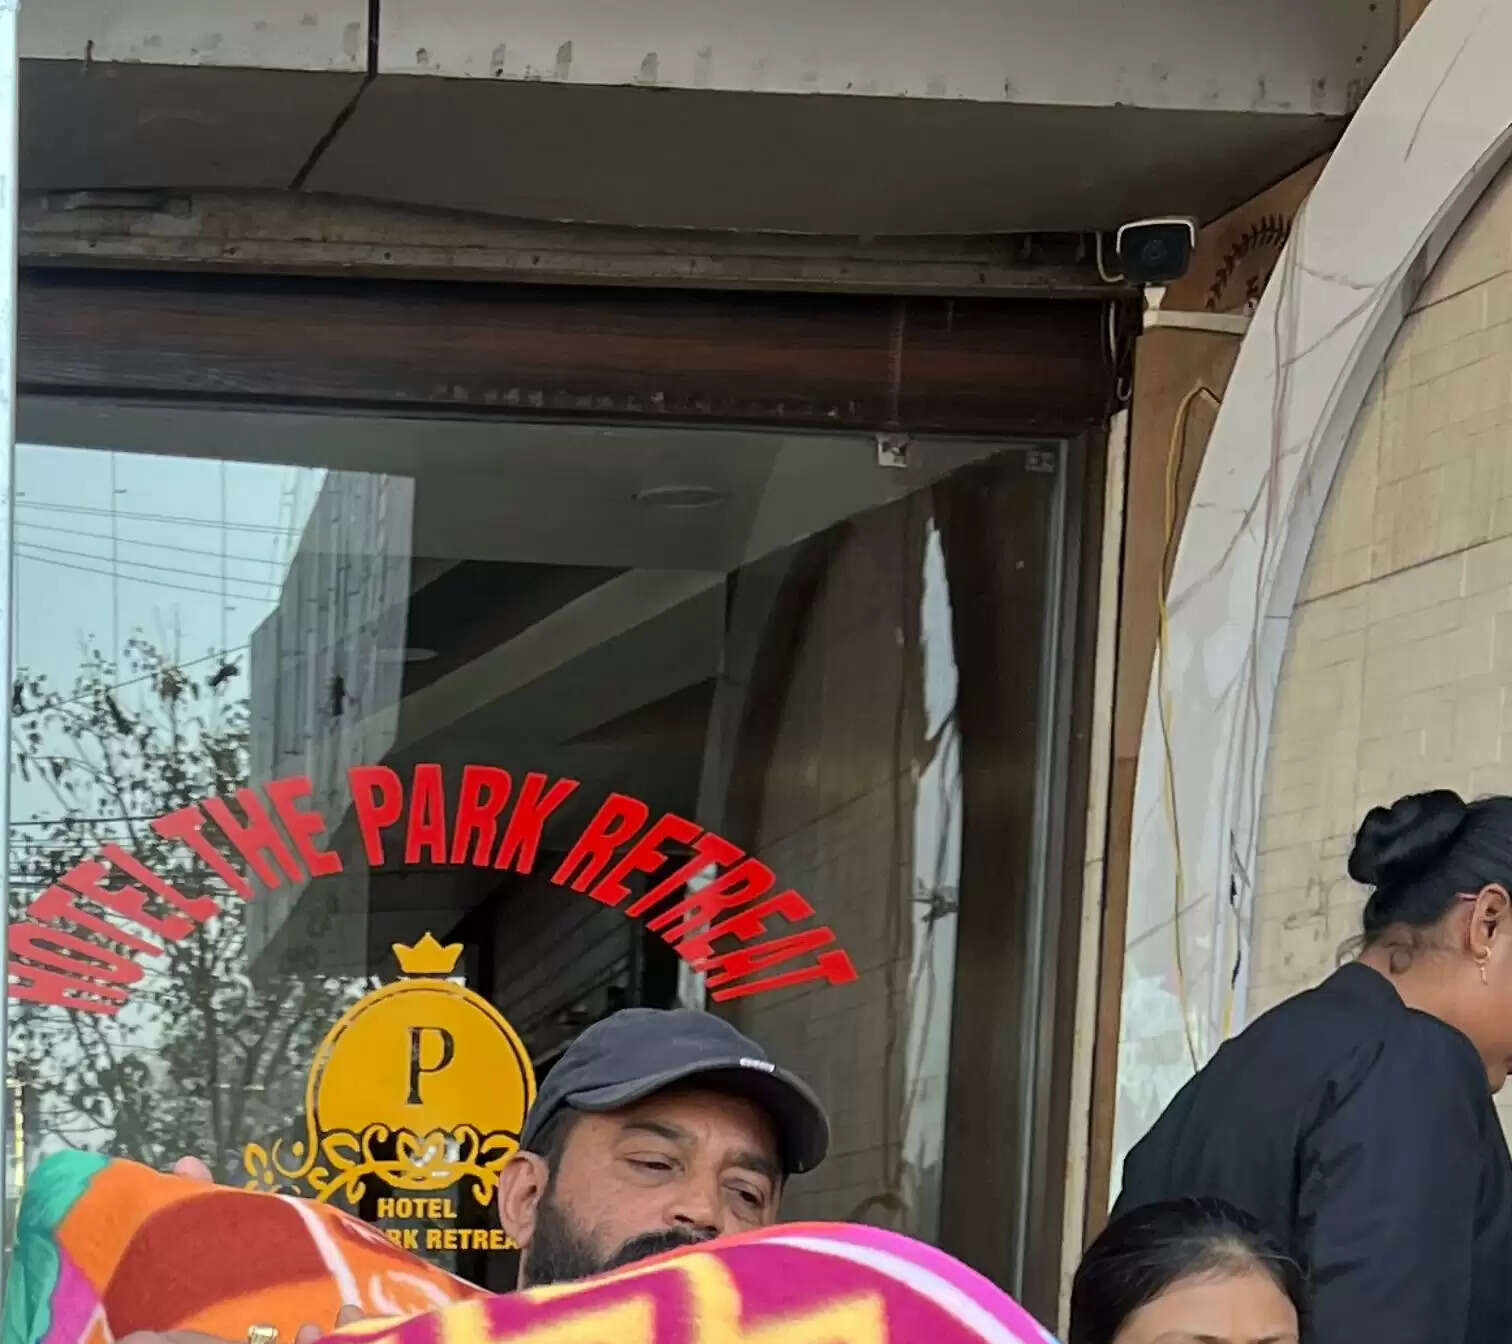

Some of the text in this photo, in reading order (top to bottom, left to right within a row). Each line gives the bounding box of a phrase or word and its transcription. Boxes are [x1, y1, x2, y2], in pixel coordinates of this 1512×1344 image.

[8, 763, 859, 1016] HOTEL THE PARK RETREAT
[407, 1025, 455, 1105] P
[376, 1197, 458, 1219] HOTEL
[386, 1228, 521, 1250] RK RETREA
